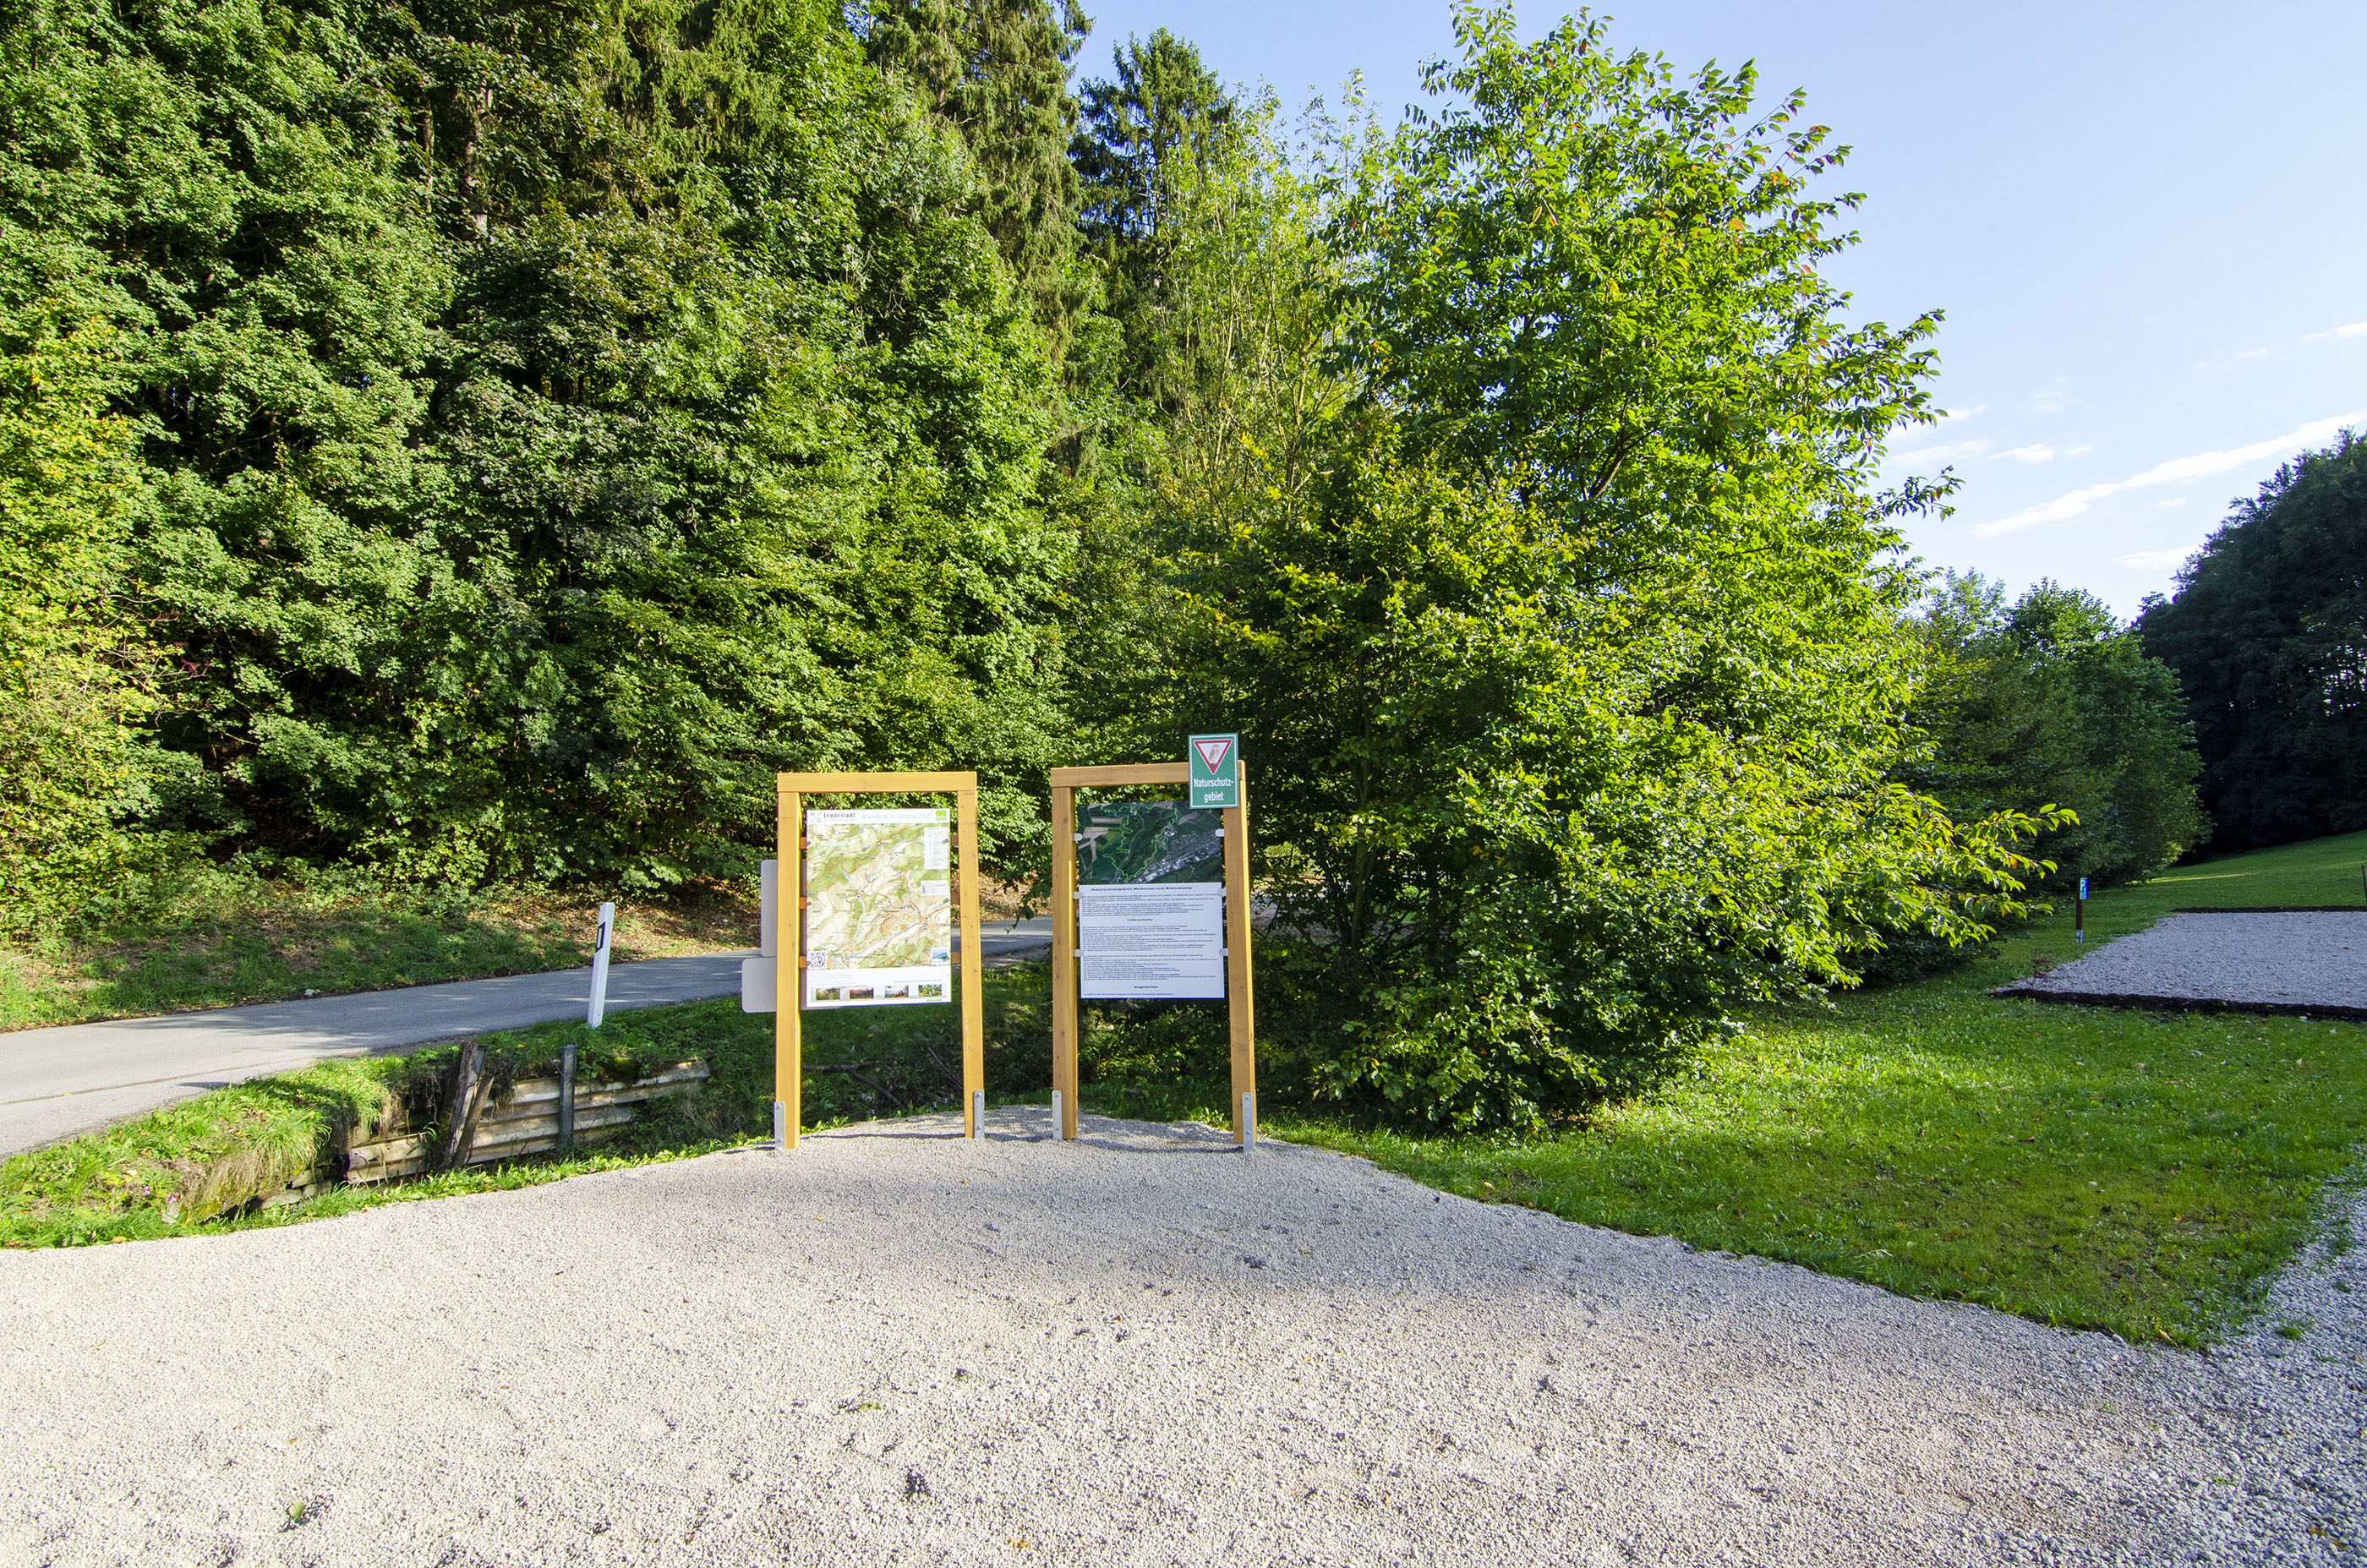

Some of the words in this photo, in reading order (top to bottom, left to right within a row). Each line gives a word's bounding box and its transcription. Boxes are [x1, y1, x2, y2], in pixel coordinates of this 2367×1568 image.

[1194, 778, 1234, 787] Naturschutz-
[1204, 791, 1224, 804] gebiet
[2080, 879, 2085, 891] P
